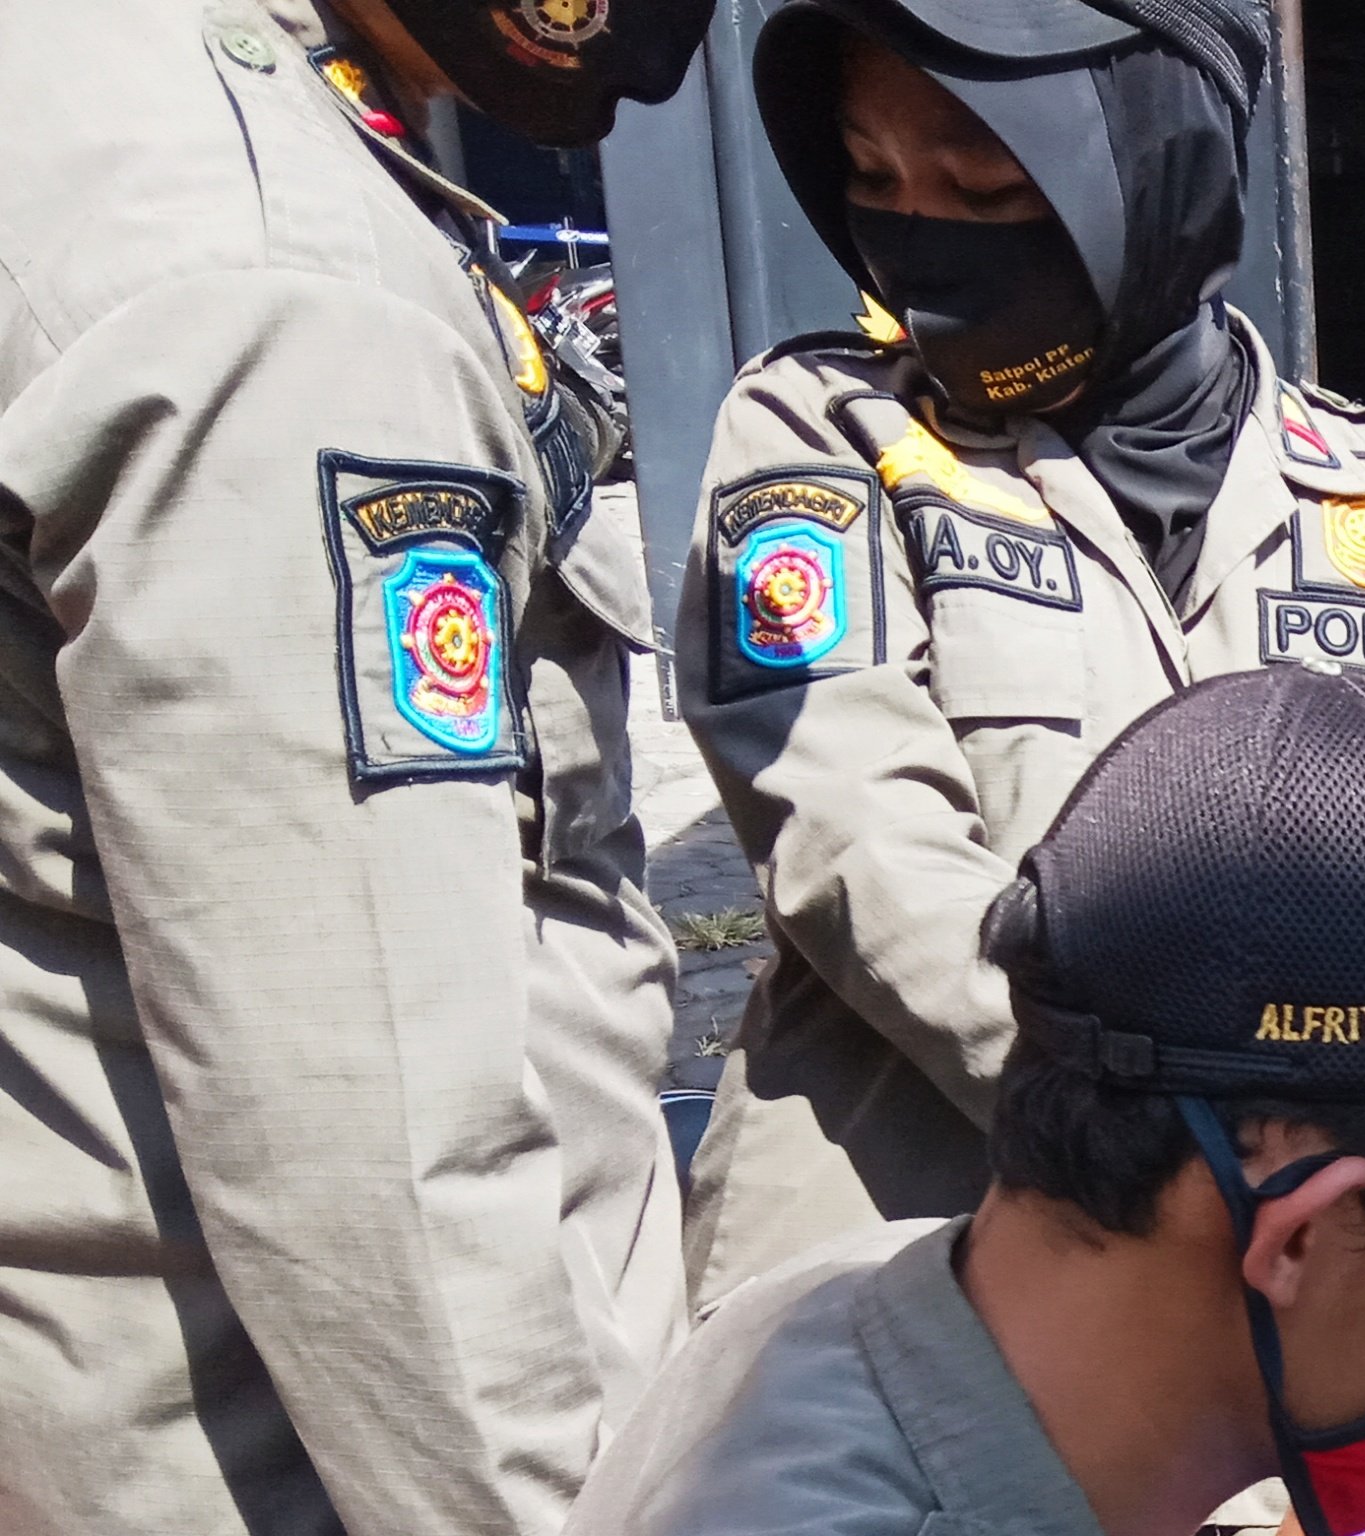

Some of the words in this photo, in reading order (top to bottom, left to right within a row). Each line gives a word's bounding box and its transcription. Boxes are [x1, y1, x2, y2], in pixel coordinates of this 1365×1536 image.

[980, 356, 1041, 384] Satpol
[1045, 343, 1070, 363] PP
[986, 380, 1033, 400] Kab.
[1035, 347, 1094, 382] Klaten
